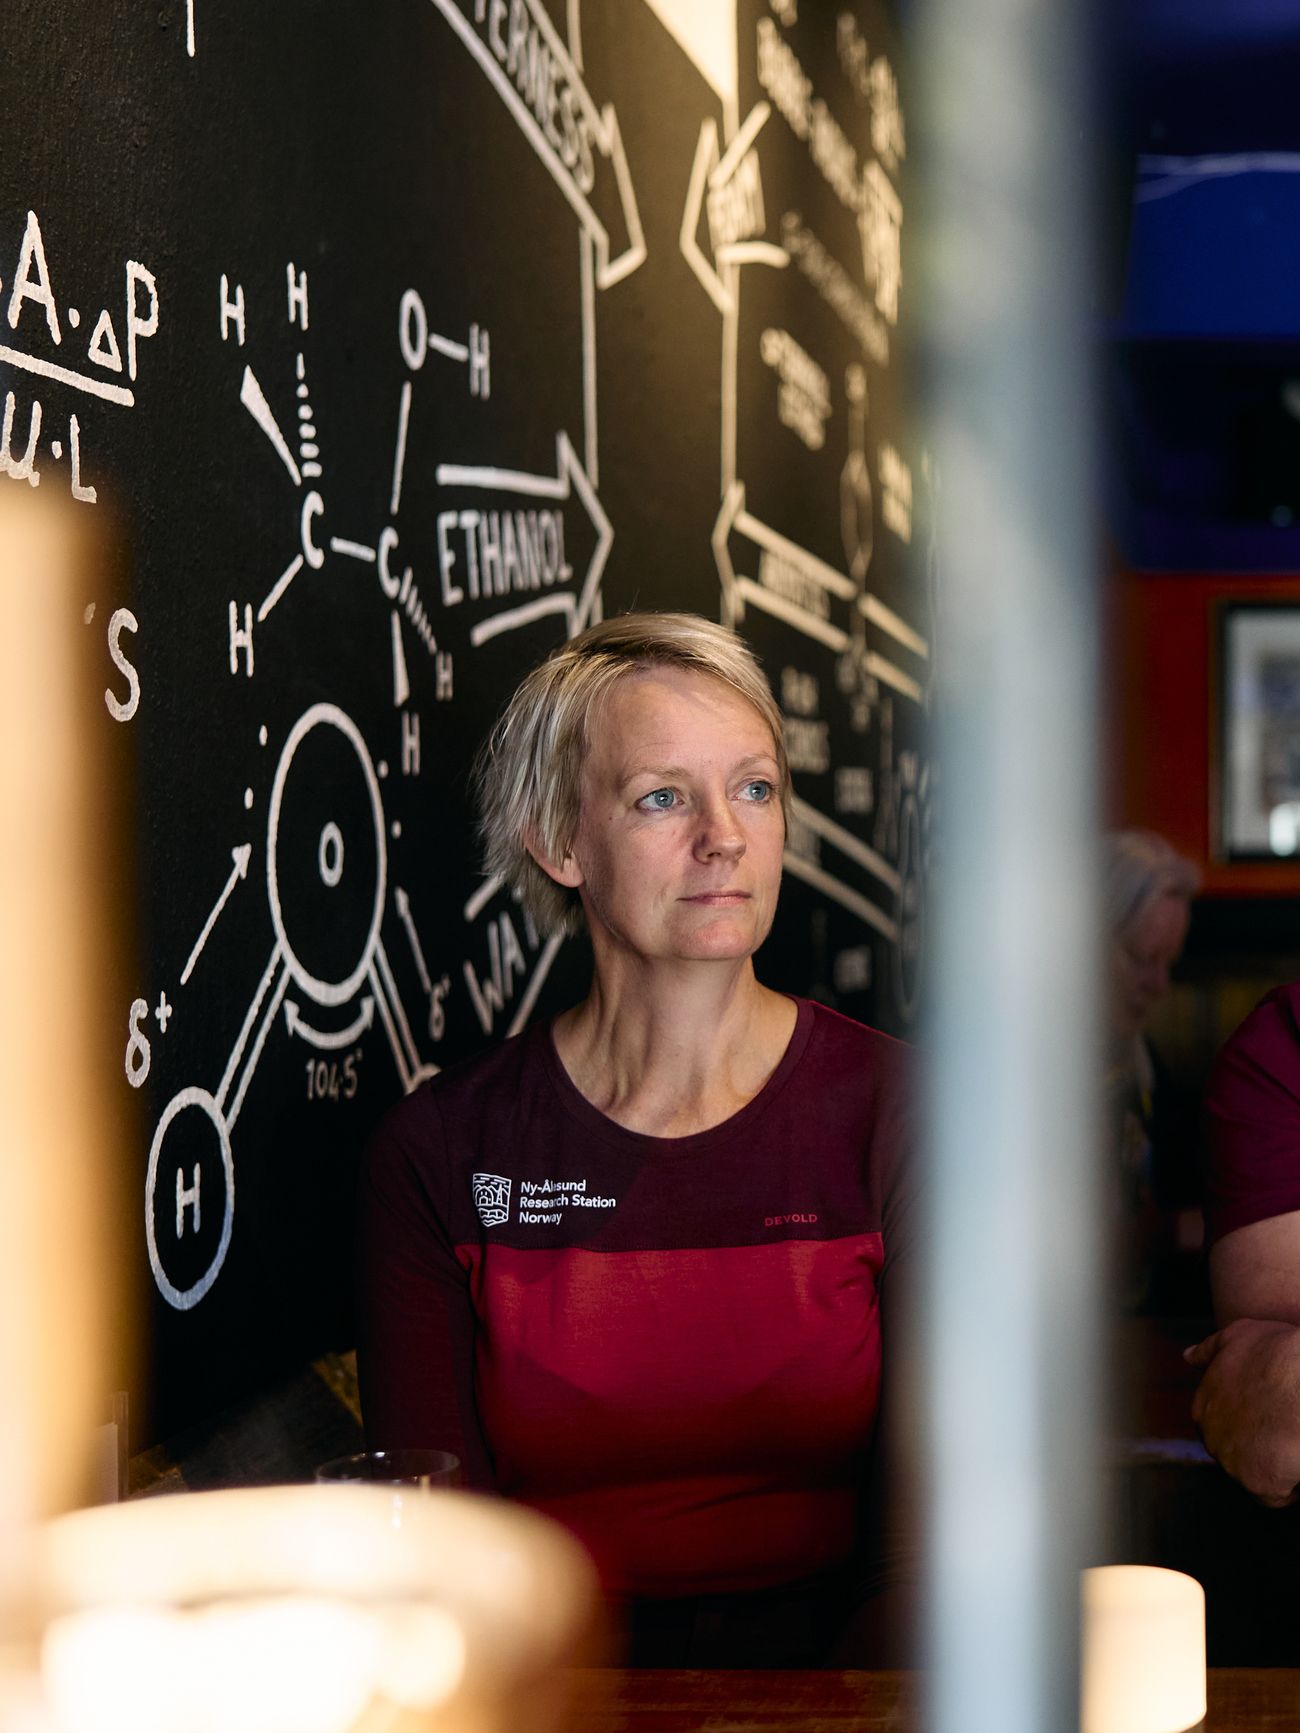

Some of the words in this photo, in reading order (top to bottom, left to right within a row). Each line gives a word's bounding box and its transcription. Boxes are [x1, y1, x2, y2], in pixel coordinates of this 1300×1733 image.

[436, 508, 574, 607] ETHANOL
[520, 1194, 569, 1209] Research
[571, 1193, 617, 1209] Station
[519, 1211, 563, 1226] Norway
[764, 1213, 819, 1227] DEVOLD
